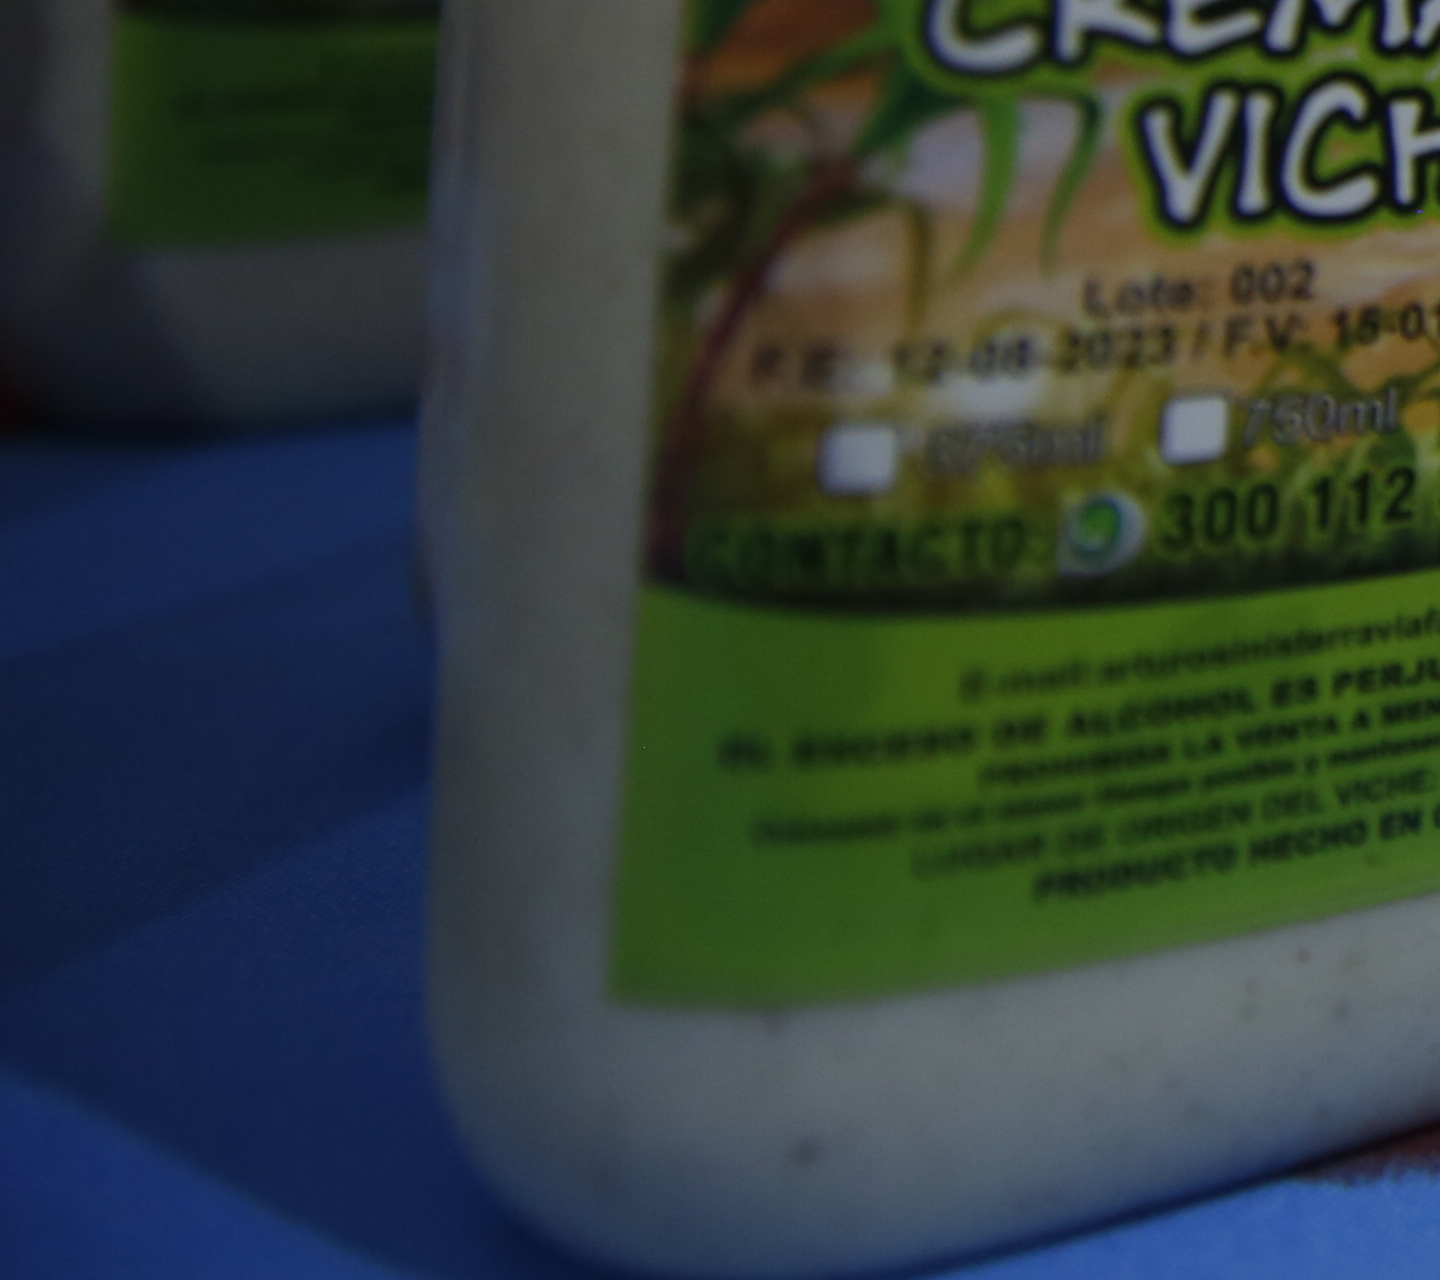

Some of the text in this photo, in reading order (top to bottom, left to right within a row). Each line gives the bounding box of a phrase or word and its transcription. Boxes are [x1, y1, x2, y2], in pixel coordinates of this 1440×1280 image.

[1228, 258, 1317, 307] 002
[1241, 385, 1399, 446] 750ml
[1163, 481, 1281, 548] 300
[1307, 466, 1418, 532] 112
[1270, 675, 1319, 709] ES
[1351, 709, 1371, 732] A
[1378, 803, 1424, 841] EN
